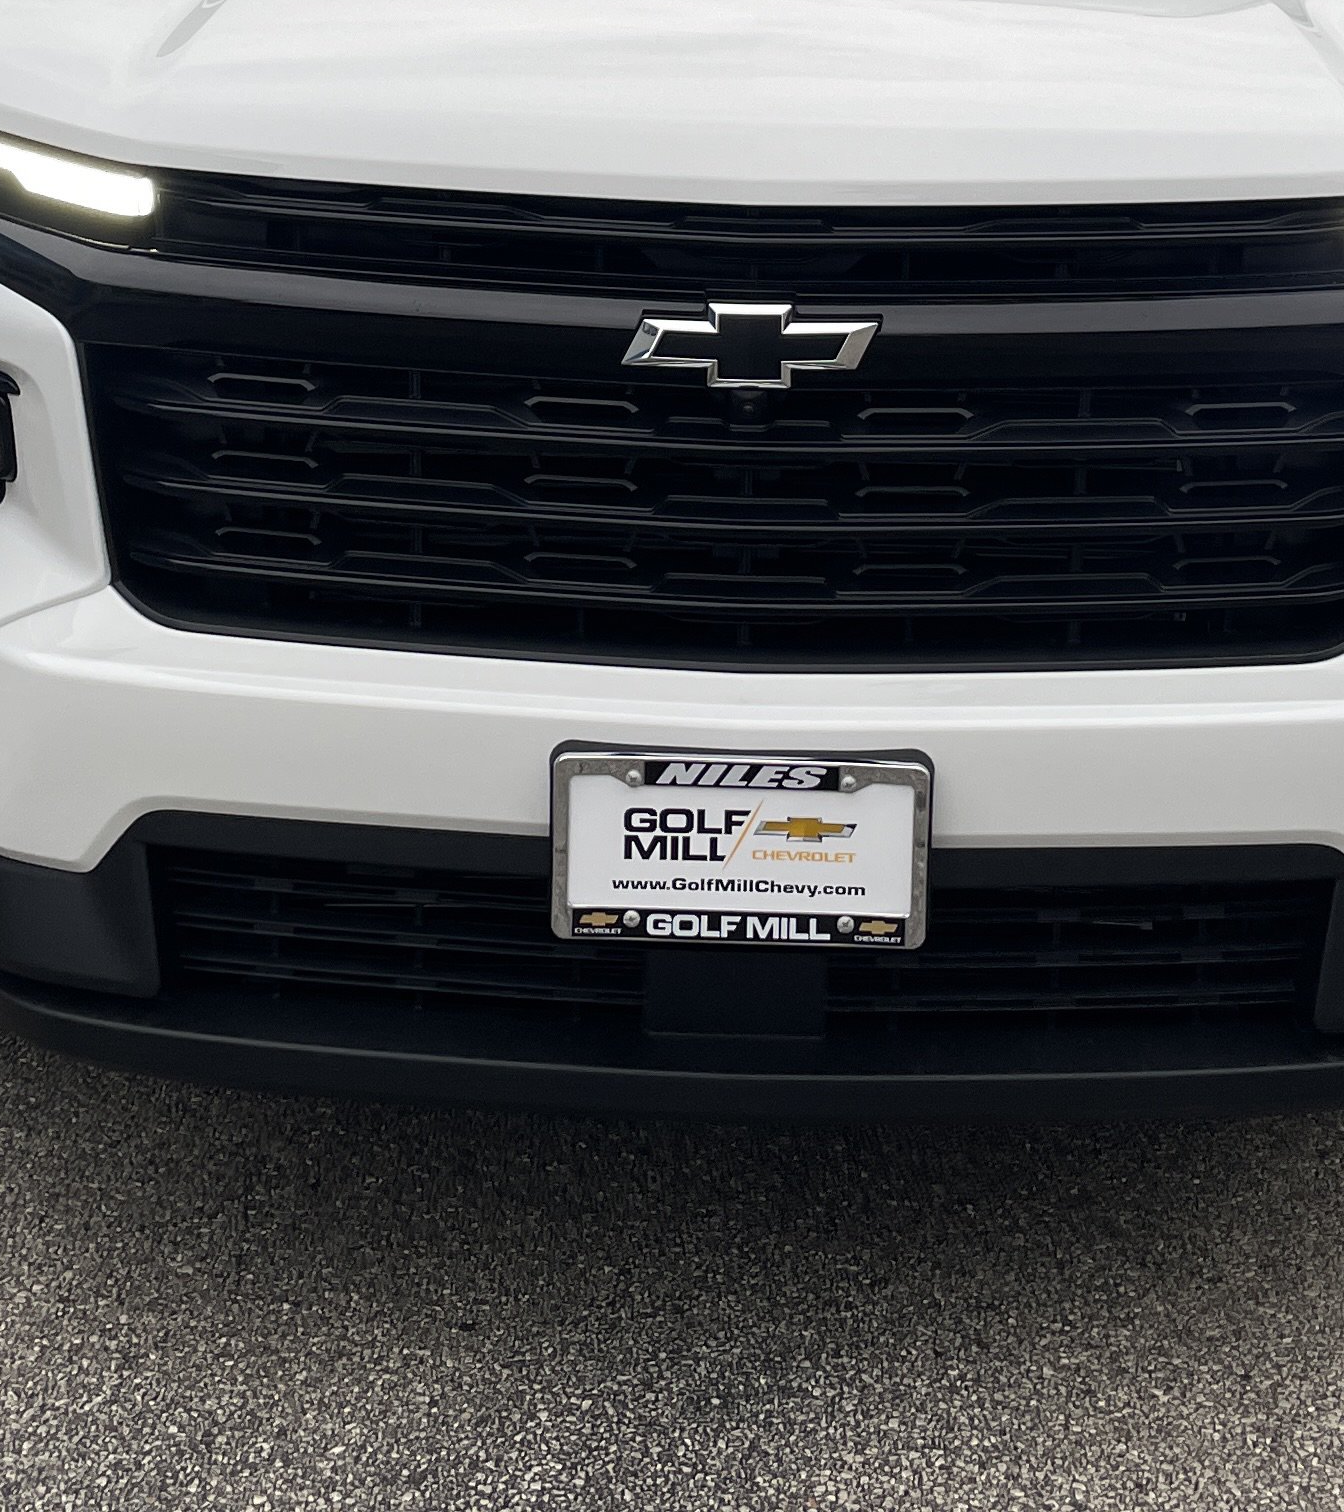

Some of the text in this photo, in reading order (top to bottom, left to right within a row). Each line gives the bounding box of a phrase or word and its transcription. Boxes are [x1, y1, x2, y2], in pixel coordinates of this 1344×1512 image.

[656, 763, 828, 789] NILES
[623, 807, 752, 835] GOLF
[623, 836, 727, 862] MILL
[752, 849, 857, 863] CHEVROLET
[612, 877, 866, 897] www.GolfMillChevy.com
[574, 927, 622, 935] CHEVROLET
[646, 914, 831, 940] GOLF MILL
[854, 935, 902, 944] CHEVROLET
